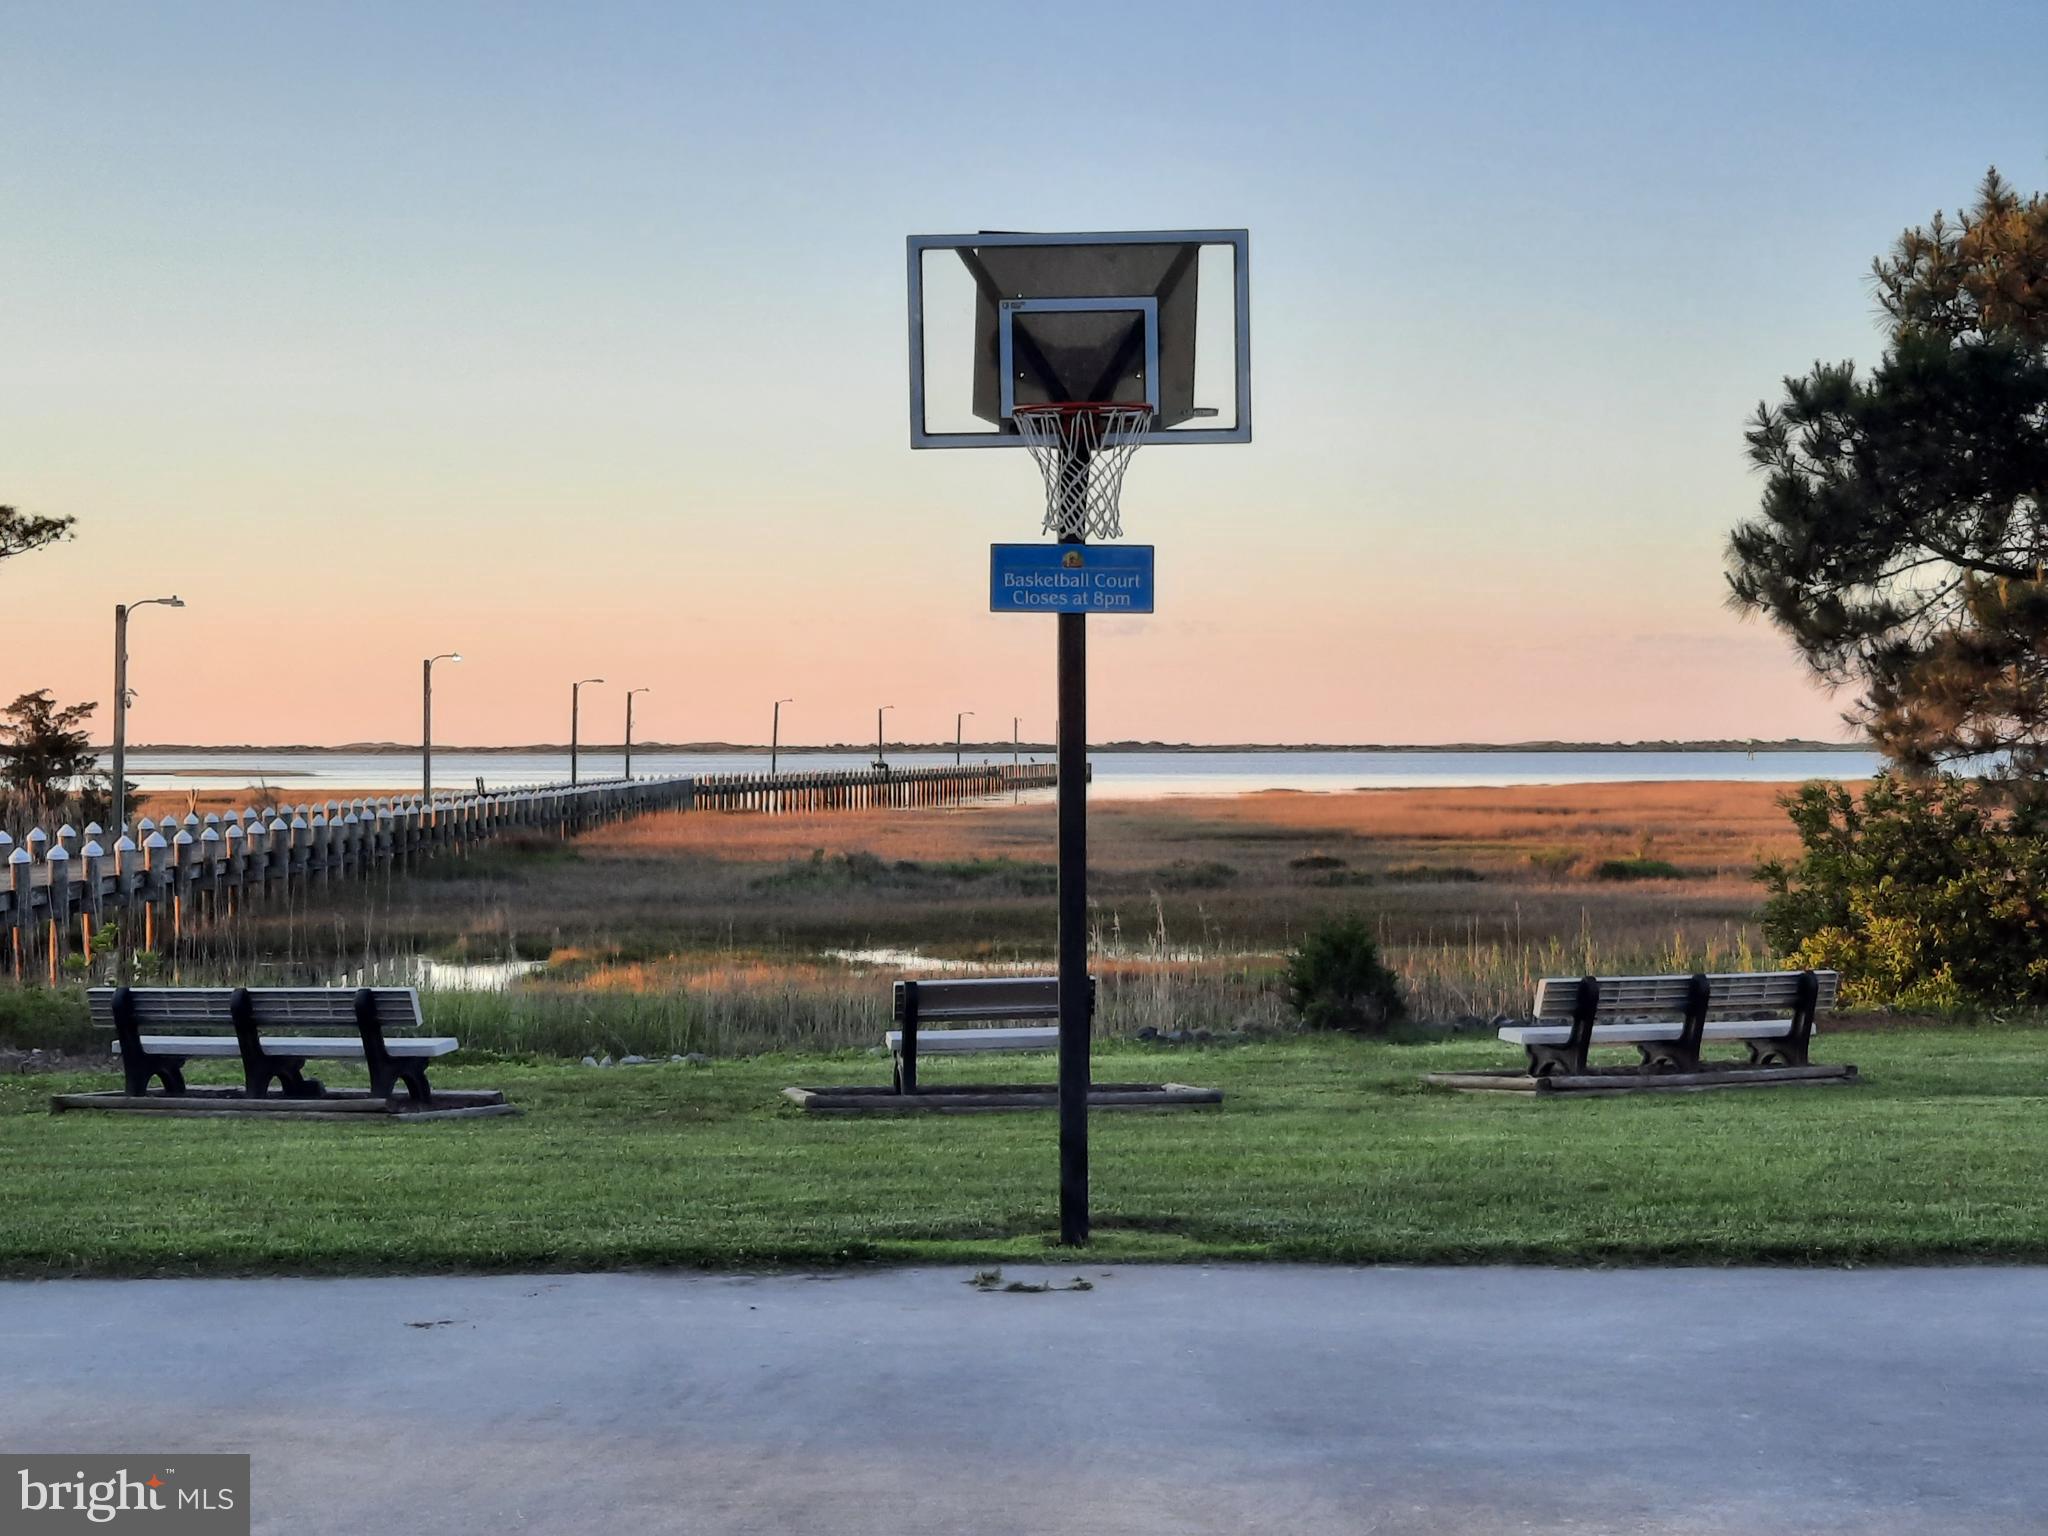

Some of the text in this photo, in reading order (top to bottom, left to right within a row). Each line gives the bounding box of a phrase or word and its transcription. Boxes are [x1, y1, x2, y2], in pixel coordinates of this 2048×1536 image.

[1004, 573, 1140, 588] Basketball Court
[1012, 590, 1131, 608] Closes at 8pm
